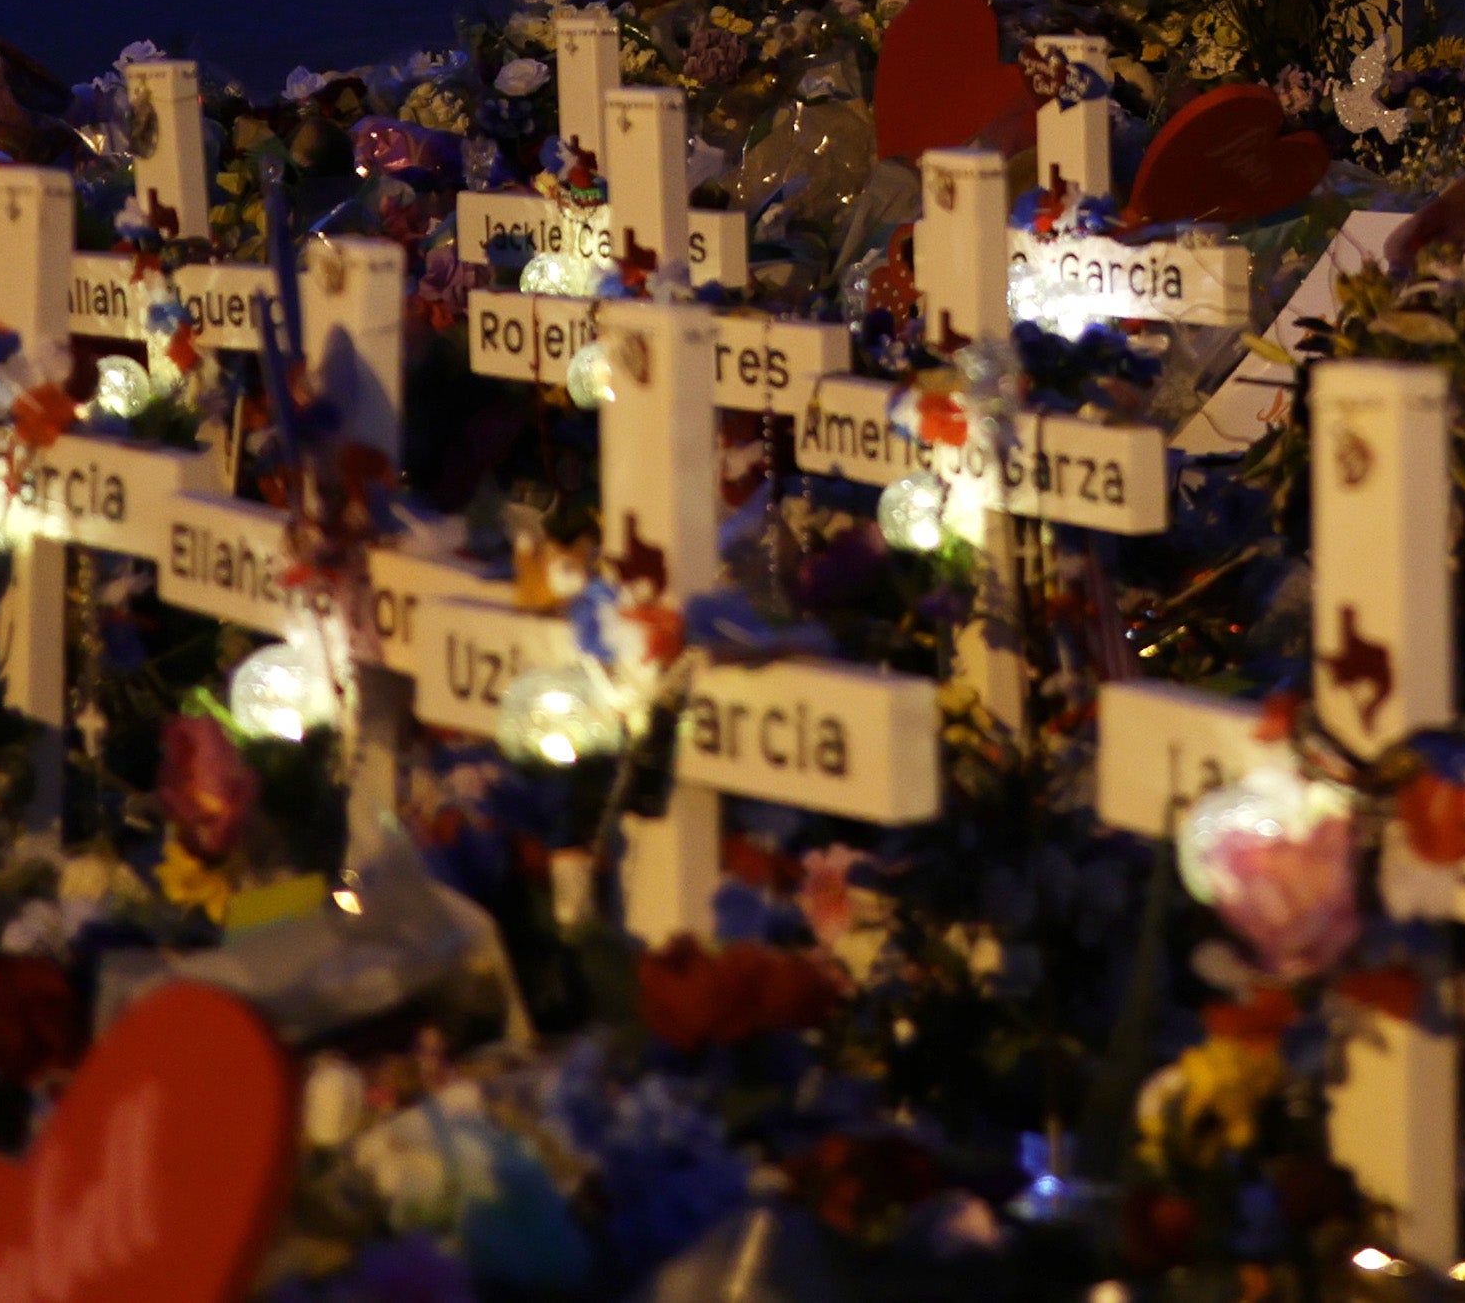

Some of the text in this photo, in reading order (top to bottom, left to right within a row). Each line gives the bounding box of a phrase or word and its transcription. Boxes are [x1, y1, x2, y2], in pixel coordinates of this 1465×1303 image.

[1060, 252, 1182, 299] Garcia
[1002, 439, 1126, 505] Garza
[690, 697, 849, 777] arcia
